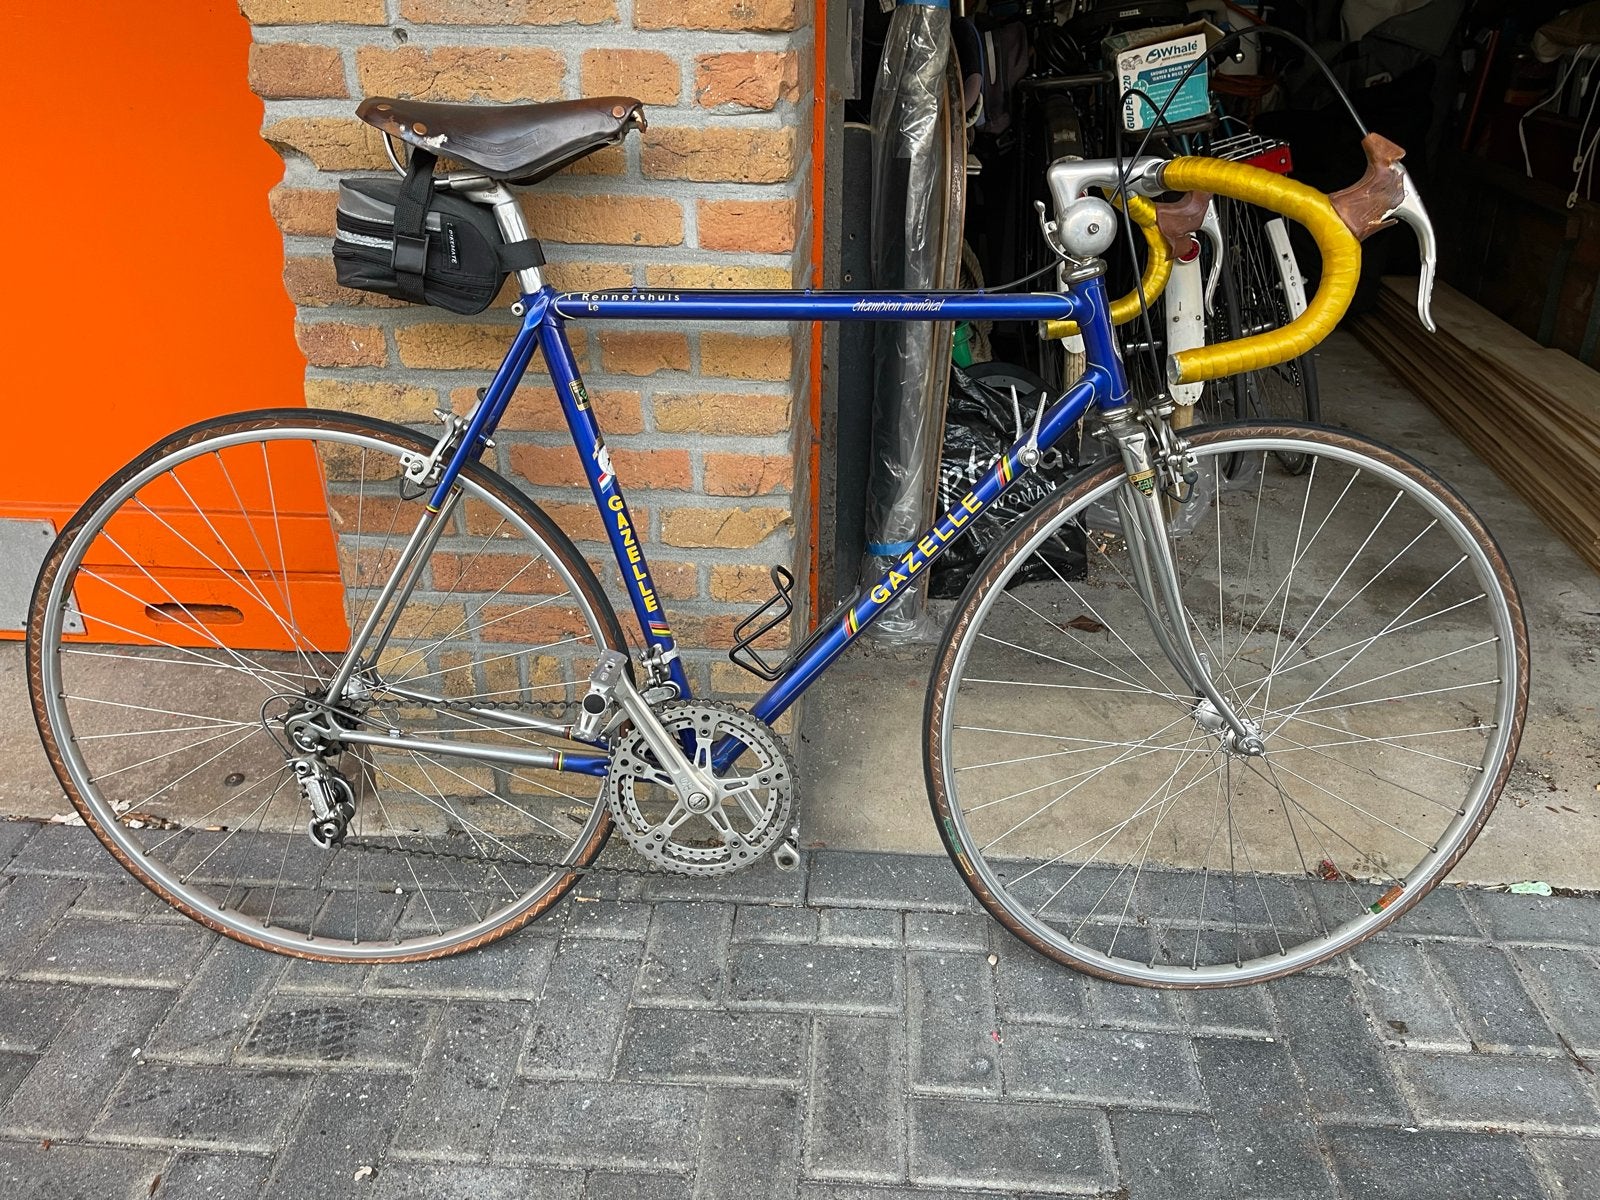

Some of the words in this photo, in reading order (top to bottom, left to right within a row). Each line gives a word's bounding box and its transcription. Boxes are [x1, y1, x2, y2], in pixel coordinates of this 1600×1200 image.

[582, 293, 680, 301] Rennershuis
[852, 299, 900, 312] champion
[992, 481, 1057, 509] WOMAN
[608, 495, 658, 613] GAZELLE
[870, 492, 983, 603] GAZELLE
